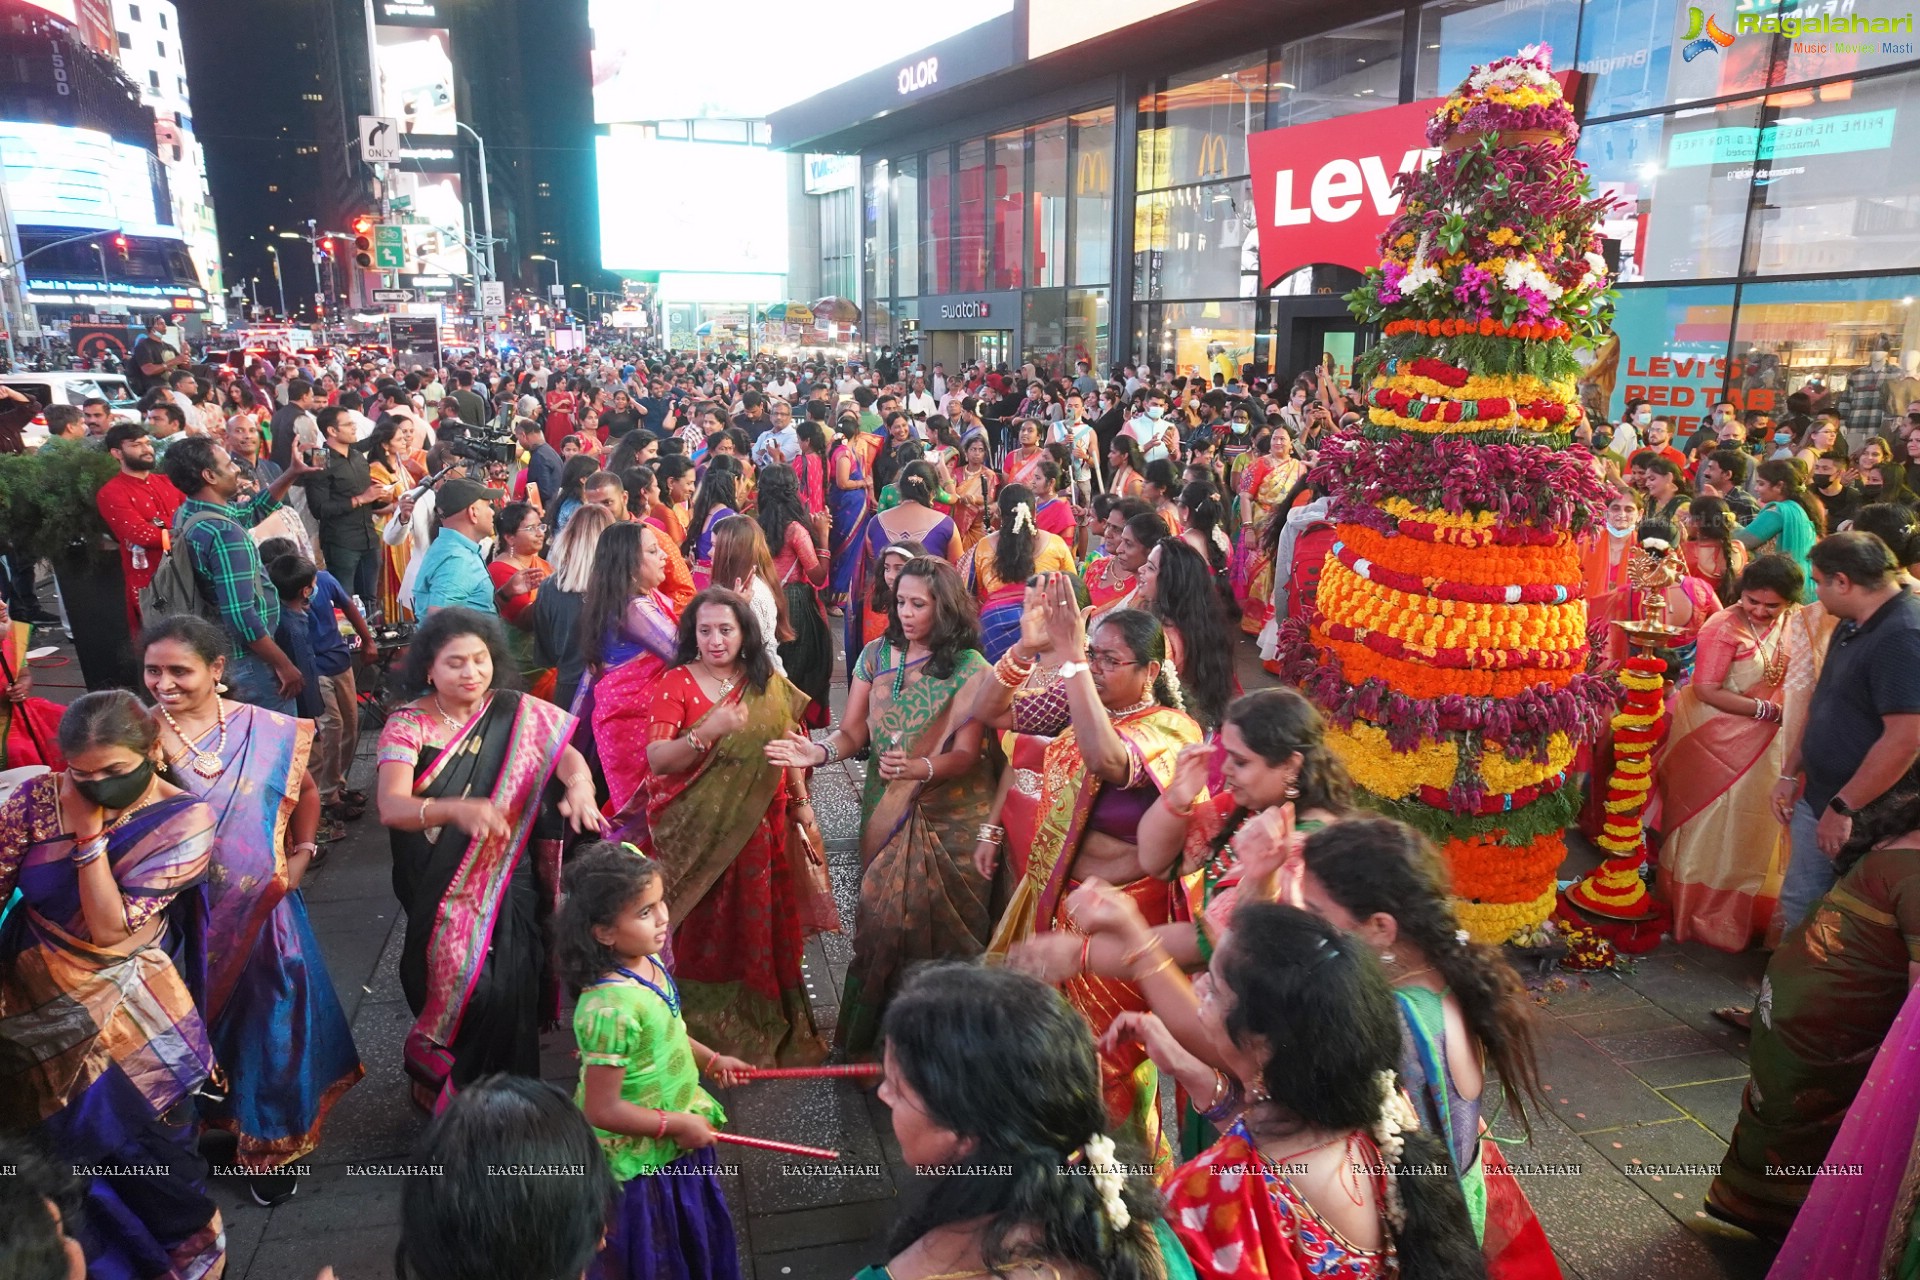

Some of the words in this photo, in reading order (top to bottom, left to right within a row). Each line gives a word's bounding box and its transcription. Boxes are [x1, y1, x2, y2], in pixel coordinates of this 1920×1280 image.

[50, 40, 70, 96] 1500
[897, 57, 938, 95] OLOR
[368, 149, 394, 158] ONLY
[486, 295, 502, 305] 25
[941, 301, 981, 318] swatch
[1627, 356, 1742, 380] LEVI'S
[1625, 385, 1696, 408] RED
[1700, 387, 1776, 412] TAB
